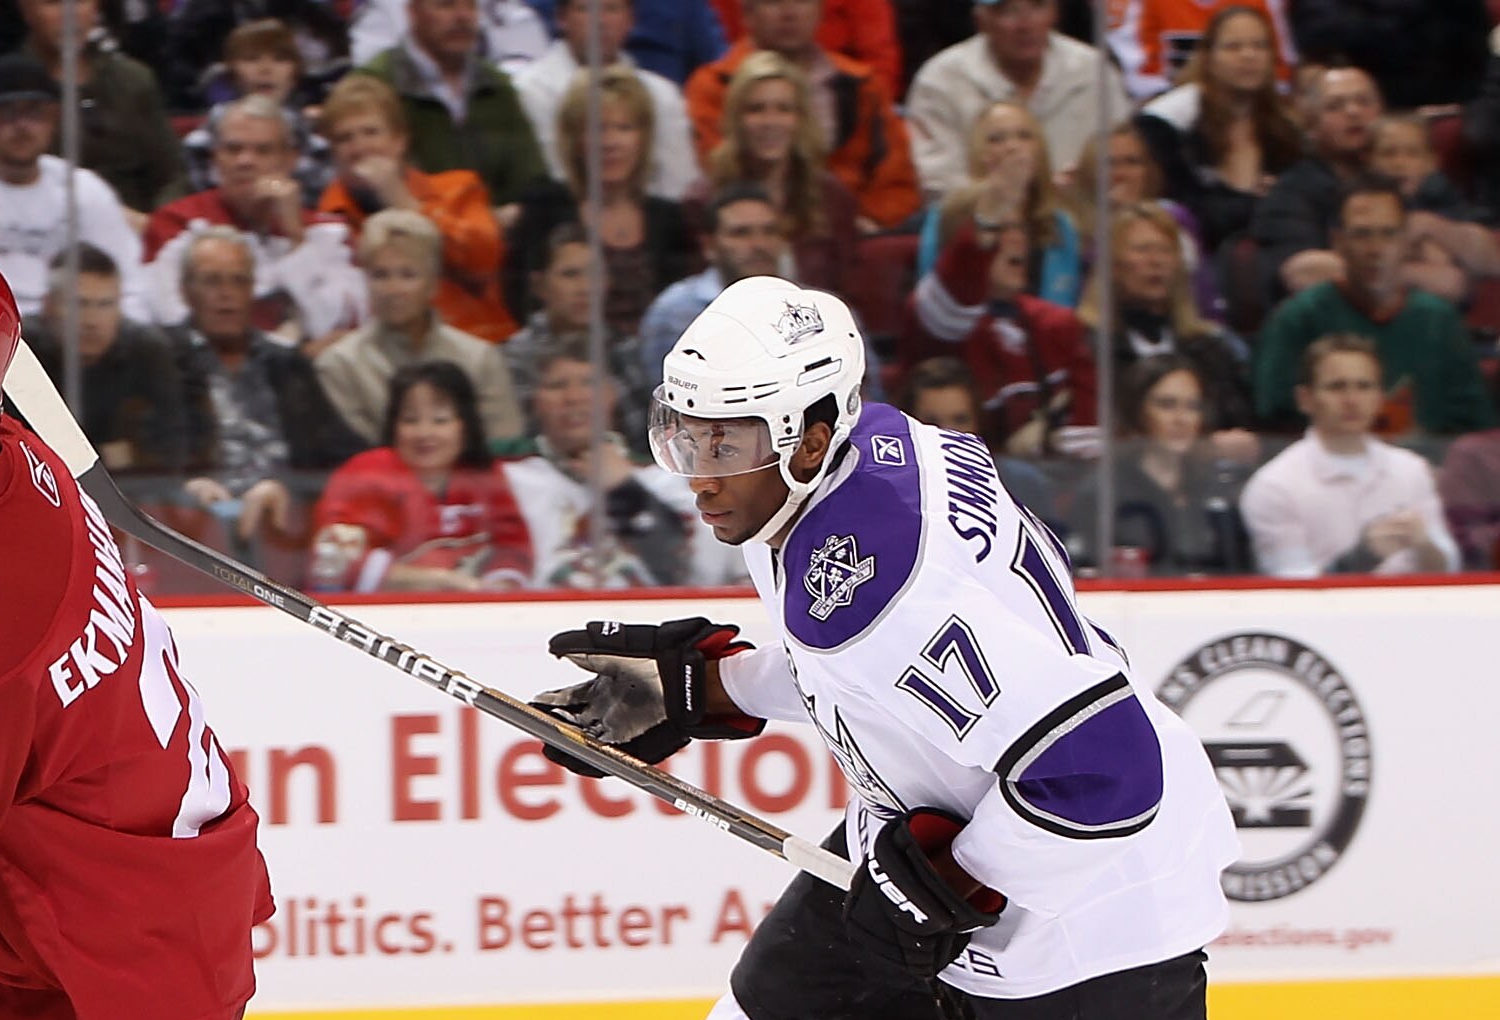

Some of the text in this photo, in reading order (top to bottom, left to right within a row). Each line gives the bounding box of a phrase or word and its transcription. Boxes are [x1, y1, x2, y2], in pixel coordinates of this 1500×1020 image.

[667, 375, 699, 391] BAUER
[895, 614, 1002, 742] 17
[673, 797, 732, 833] BAUER
[475, 892, 690, 950] Better
